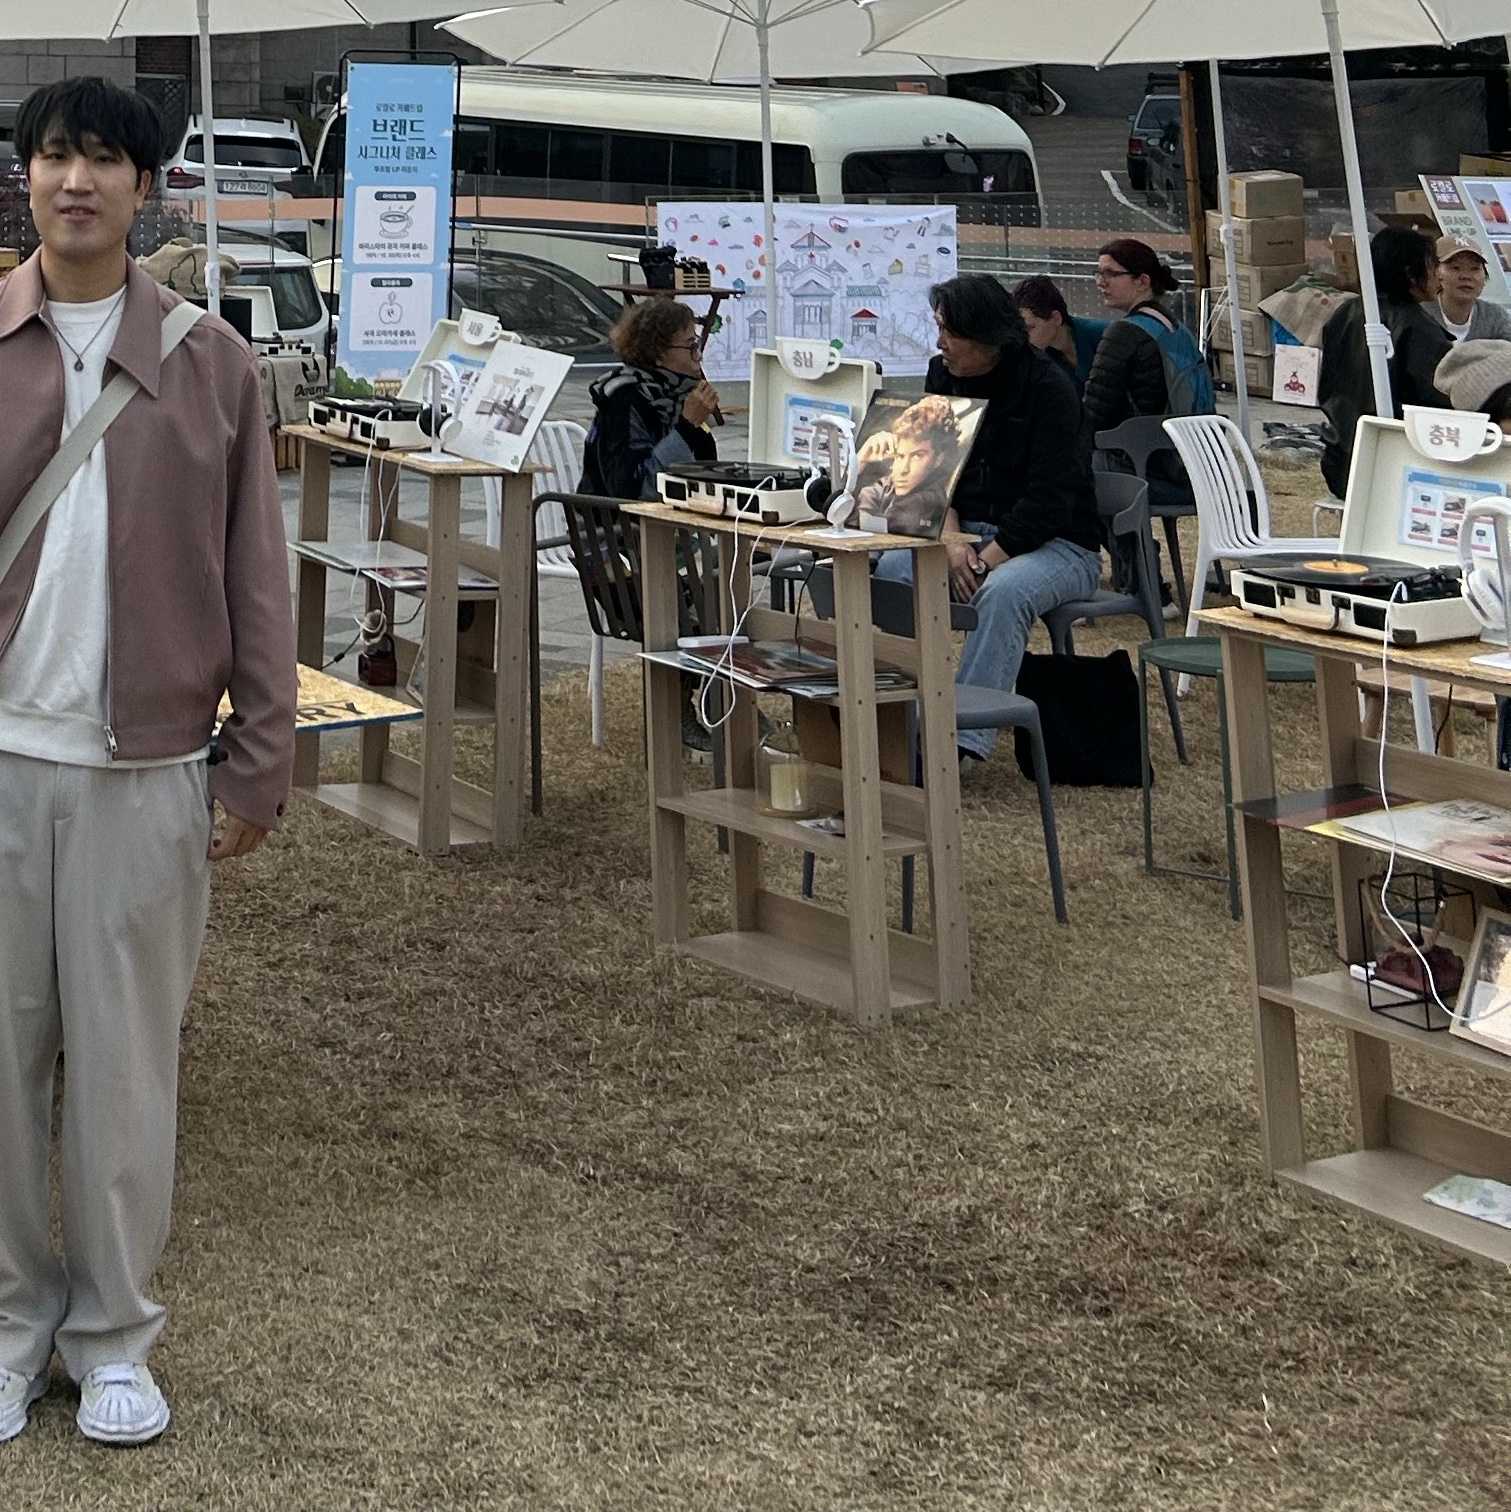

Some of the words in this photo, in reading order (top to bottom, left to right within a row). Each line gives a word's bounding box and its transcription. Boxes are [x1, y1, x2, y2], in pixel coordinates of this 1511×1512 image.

[371, 119, 425, 141] 브랜드
[405, 145, 437, 160] 클래스
[1441, 216, 1472, 226] BRAND
[1430, 424, 1460, 447] 충북
